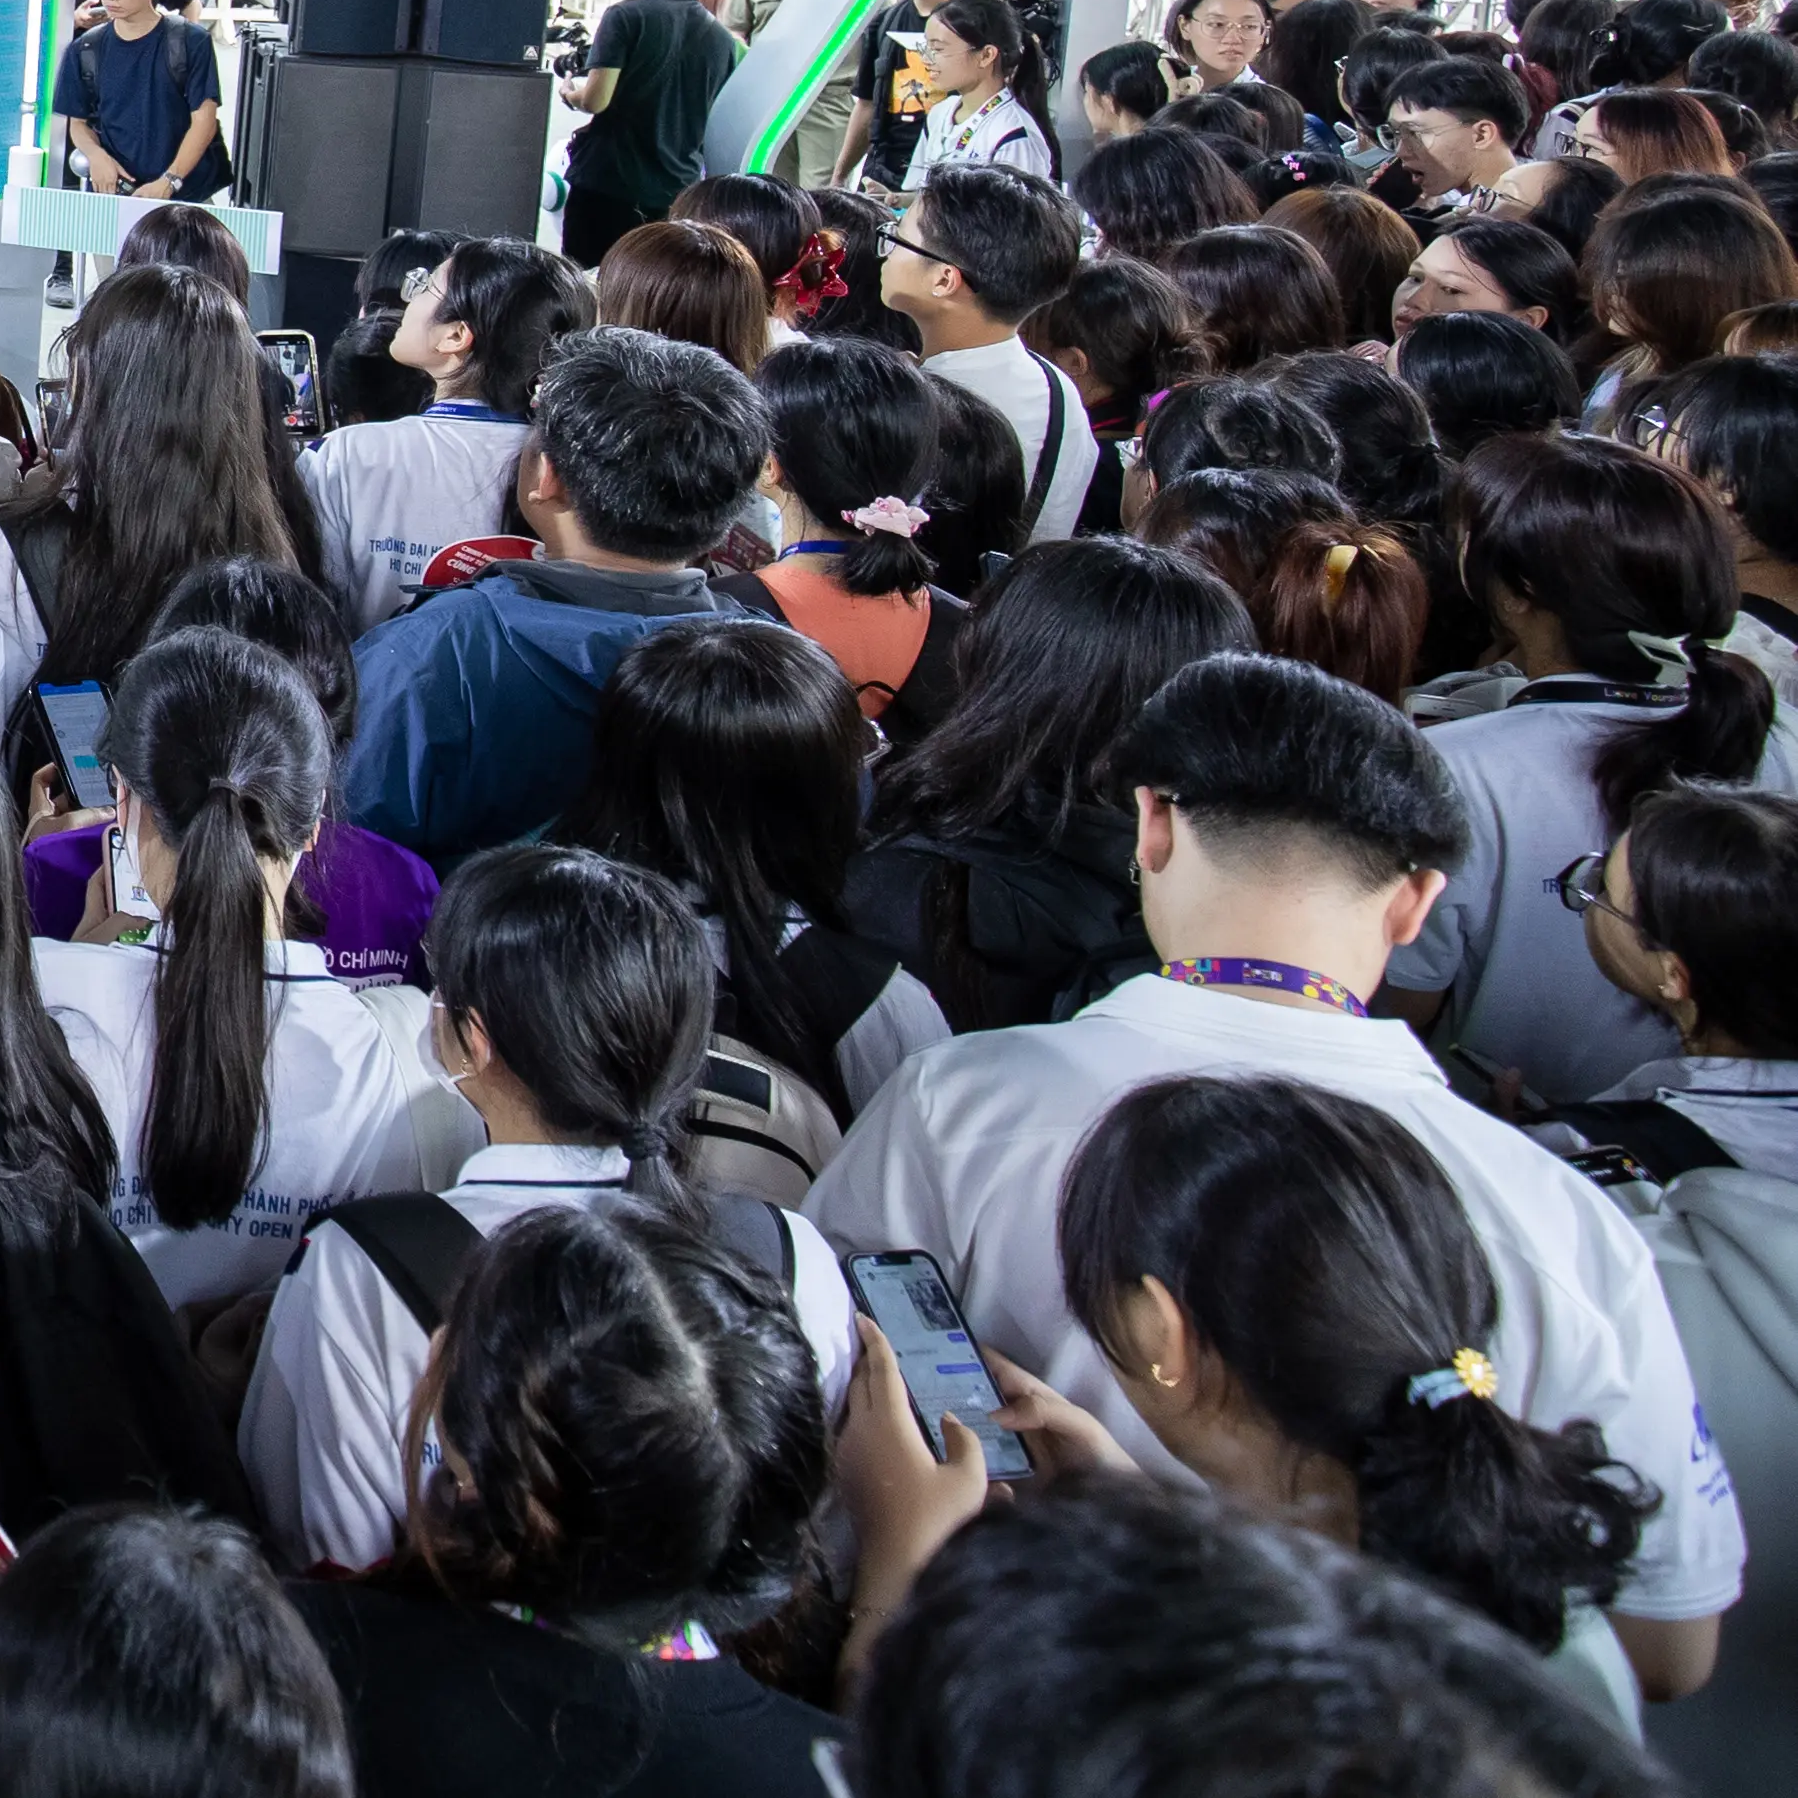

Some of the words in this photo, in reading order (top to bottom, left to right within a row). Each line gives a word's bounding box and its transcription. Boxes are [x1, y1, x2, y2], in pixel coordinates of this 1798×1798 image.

[369, 537, 405, 554] TRƯỜNG
[410, 544, 427, 558] ĐẠI
[323, 946, 334, 969] Ồ
[339, 948, 368, 969] CHÍ
[370, 949, 408, 969] MINH
[244, 1190, 291, 1216] HÀNH
[249, 1220, 293, 1239] OPEN
